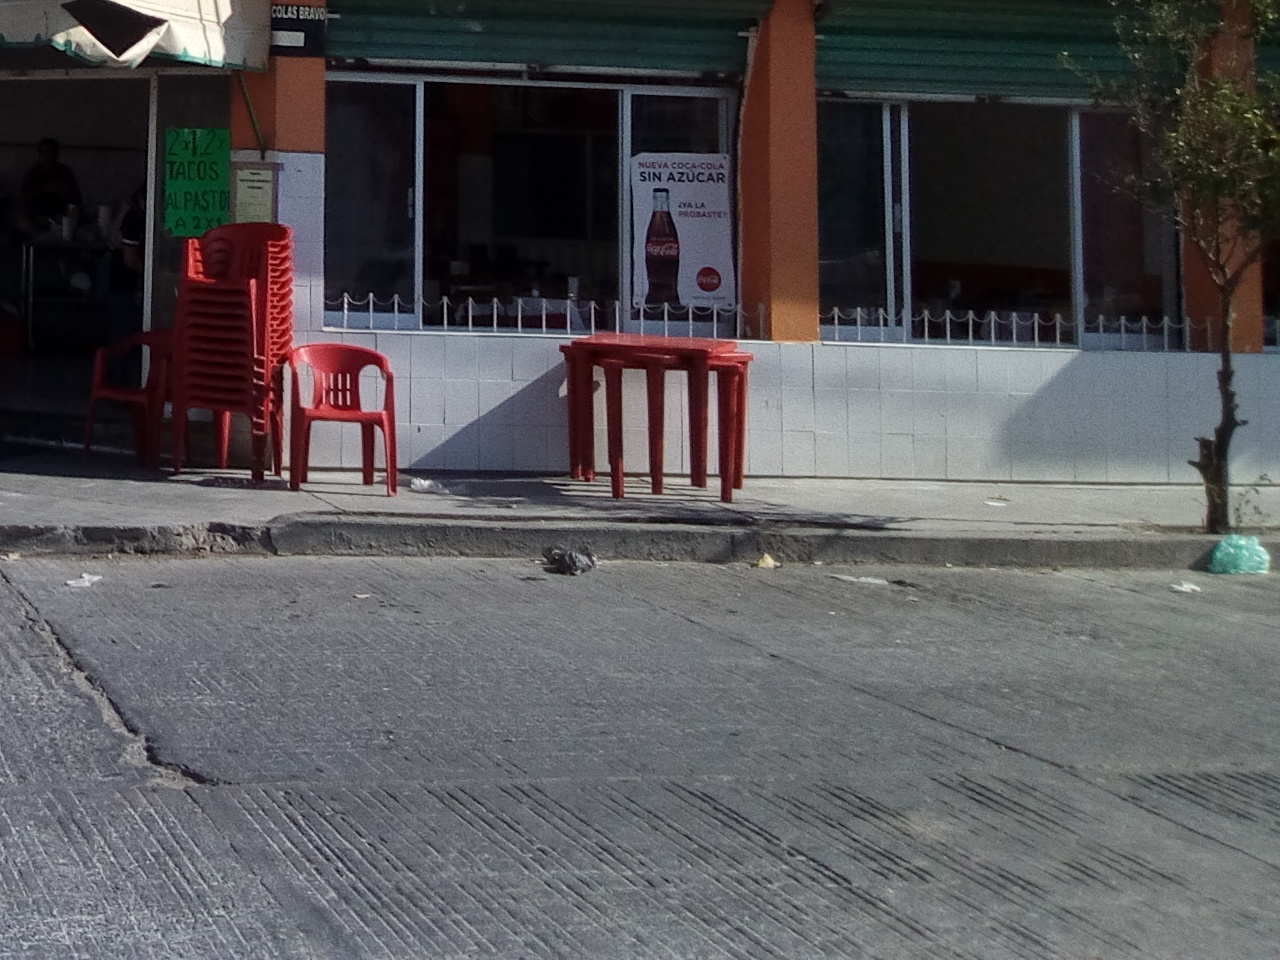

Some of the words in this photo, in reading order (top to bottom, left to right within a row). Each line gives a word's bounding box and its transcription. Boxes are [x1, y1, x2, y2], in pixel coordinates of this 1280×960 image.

[272, 6, 297, 19] COLAS
[299, 6, 325, 20] BRAVO
[166, 161, 219, 181] TACOS
[671, 162, 724, 170] COCA-COLA
[639, 171, 662, 182] SIN
